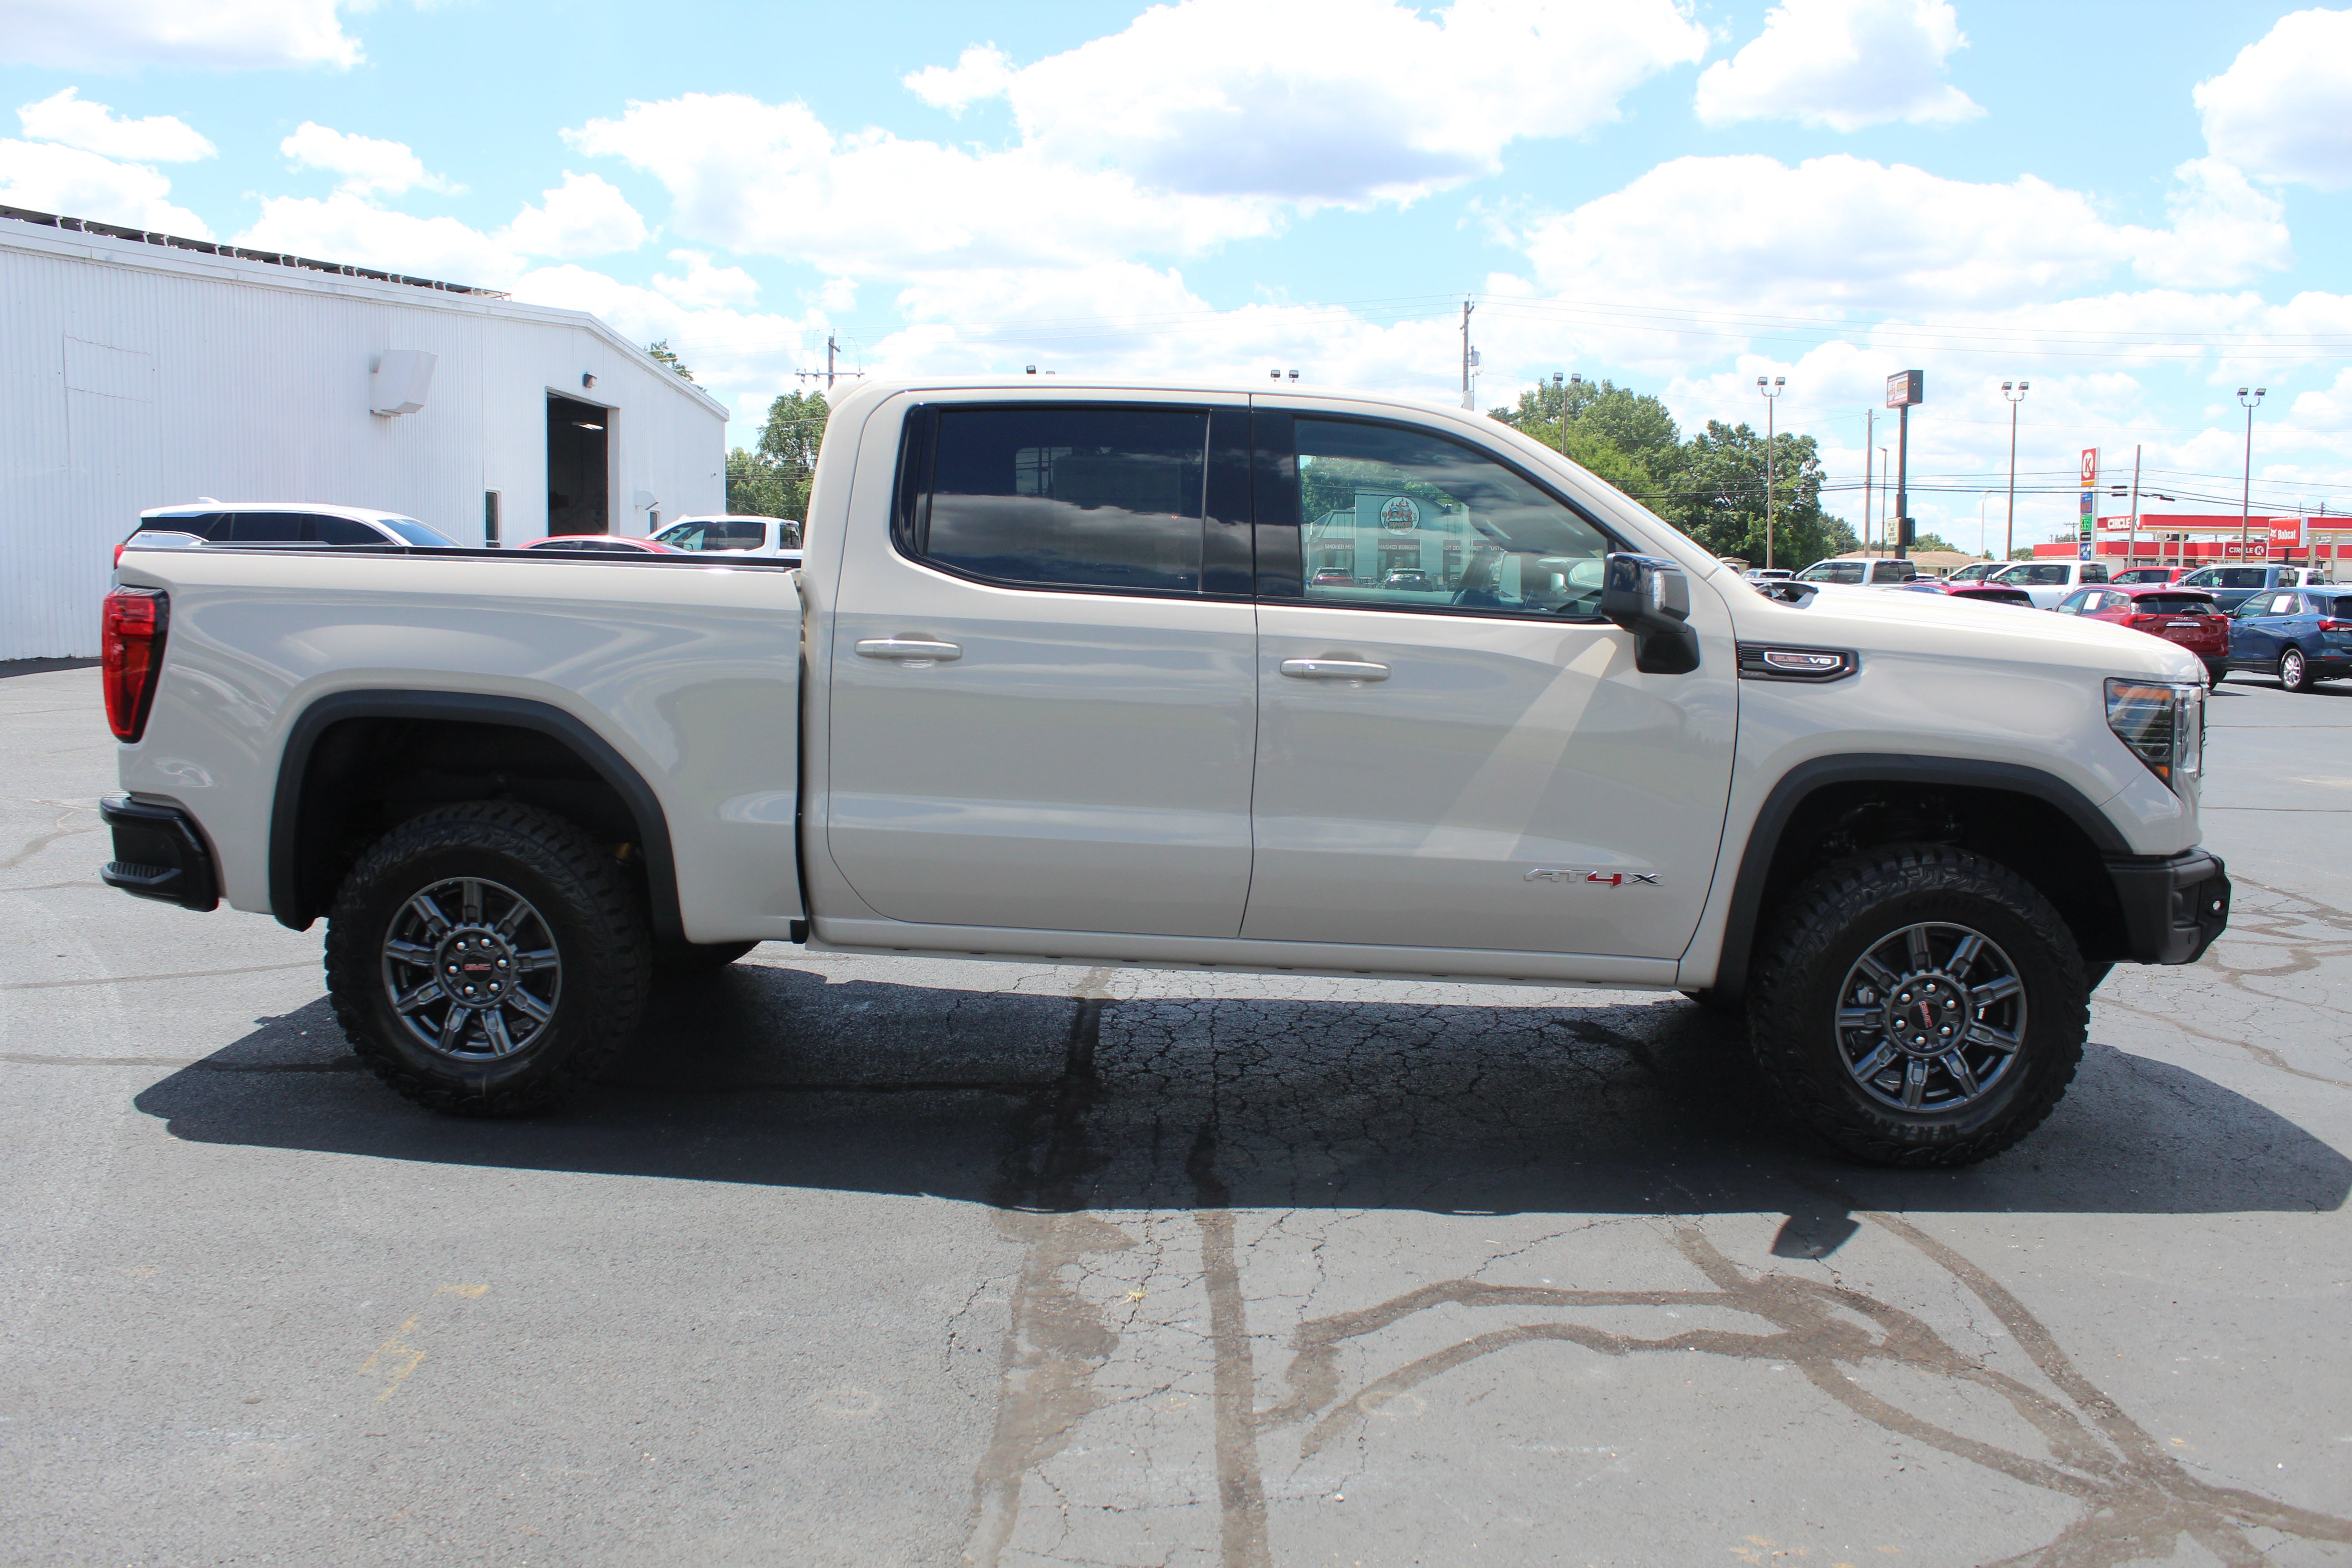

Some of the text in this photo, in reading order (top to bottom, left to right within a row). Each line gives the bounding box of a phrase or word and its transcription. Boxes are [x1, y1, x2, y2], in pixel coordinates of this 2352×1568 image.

[2107, 517, 2131, 529] CIRCLE
[2278, 529, 2296, 540] Bobcat
[1524, 868, 1663, 888] AT4X
[1919, 1001, 1933, 1028] GMC
